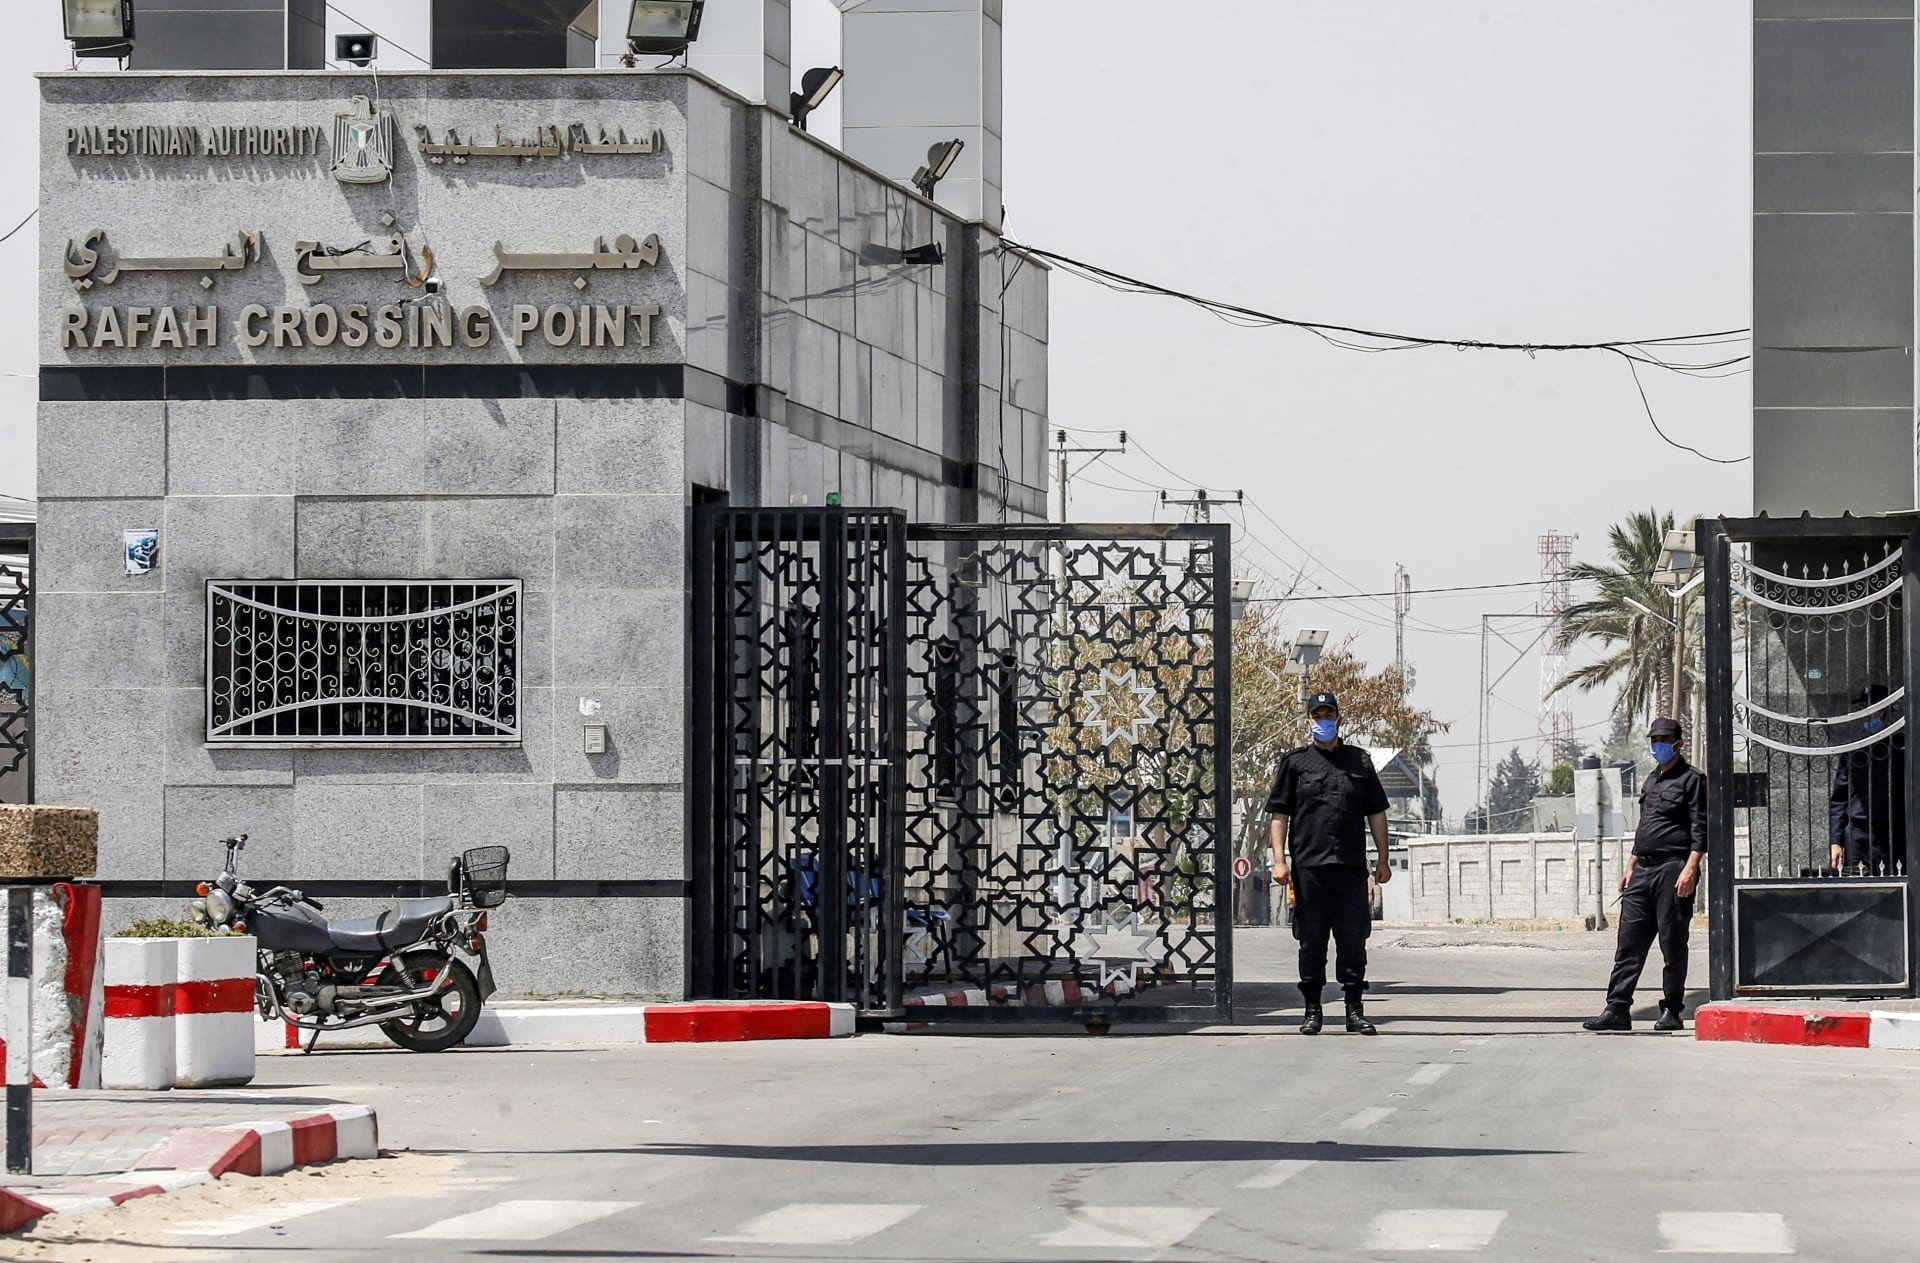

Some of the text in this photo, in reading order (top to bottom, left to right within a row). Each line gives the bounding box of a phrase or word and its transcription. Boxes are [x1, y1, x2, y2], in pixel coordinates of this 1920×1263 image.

[65, 124, 321, 157] PALESTINIAN AUTHORITY
[412, 122, 662, 166] السلطة الفلسطينية
[63, 212, 660, 290] معبر رفح البري
[62, 303, 660, 348] RAFAH CROSSING POINT
